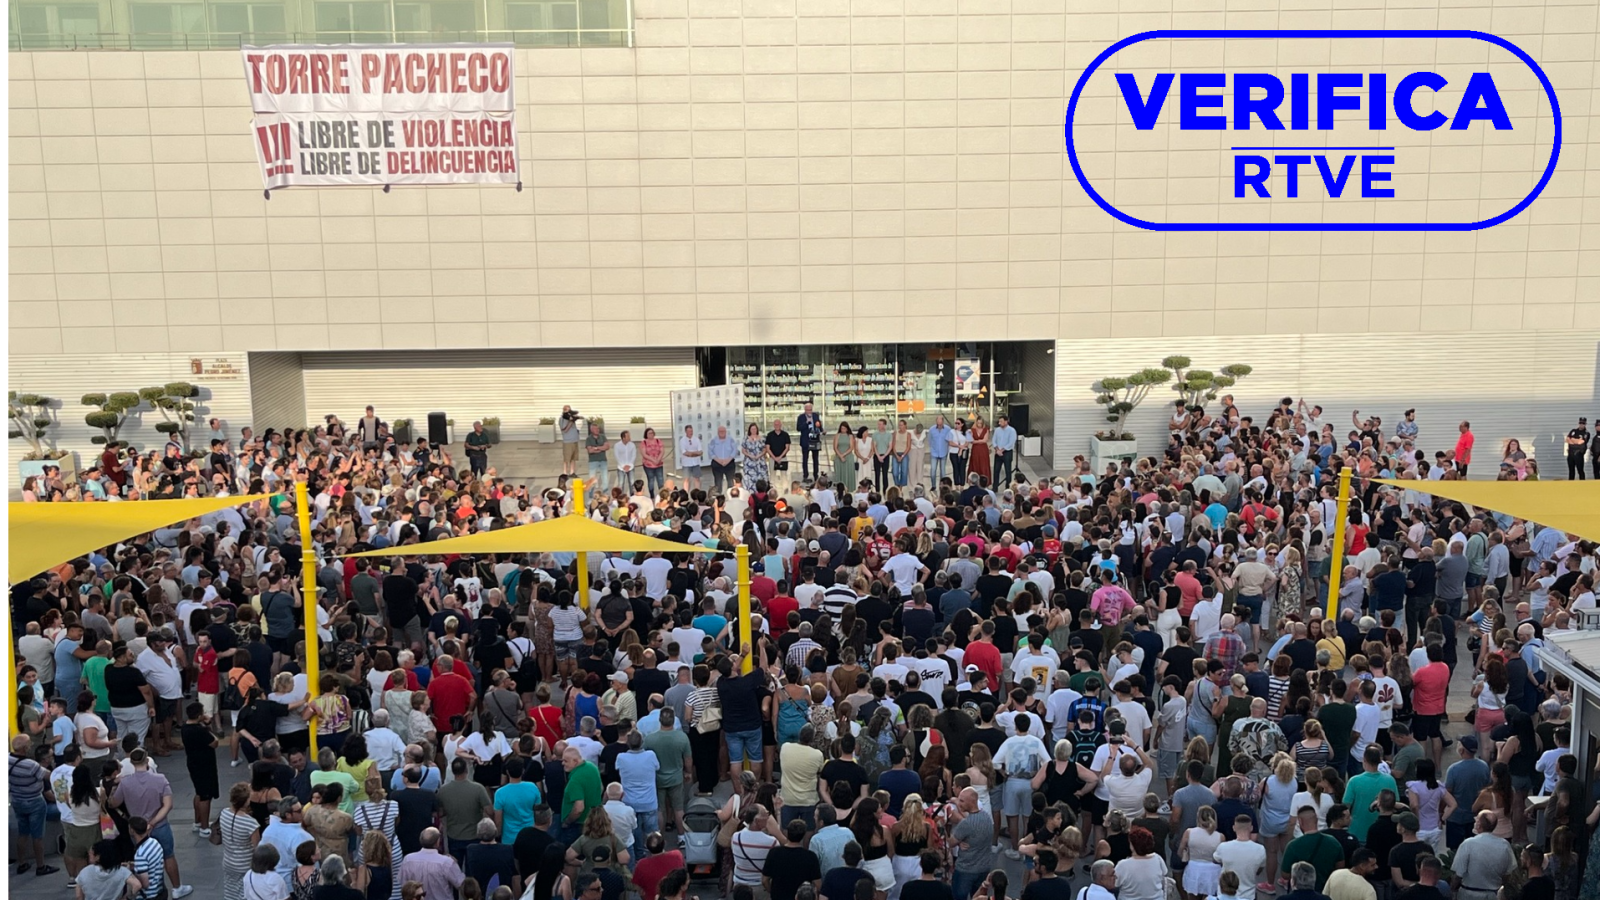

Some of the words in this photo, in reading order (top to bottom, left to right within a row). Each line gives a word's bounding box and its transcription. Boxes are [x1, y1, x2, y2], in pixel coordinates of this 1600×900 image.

[247, 53, 350, 95] TORRE
[361, 52, 510, 94] PACHECO
[297, 120, 359, 149] LIBRE
[367, 120, 395, 148] DE
[401, 119, 514, 148] VIOLENCIA
[300, 151, 352, 176] LIBRE
[357, 151, 381, 175] DE
[387, 150, 516, 175] DELINCUENCIA
